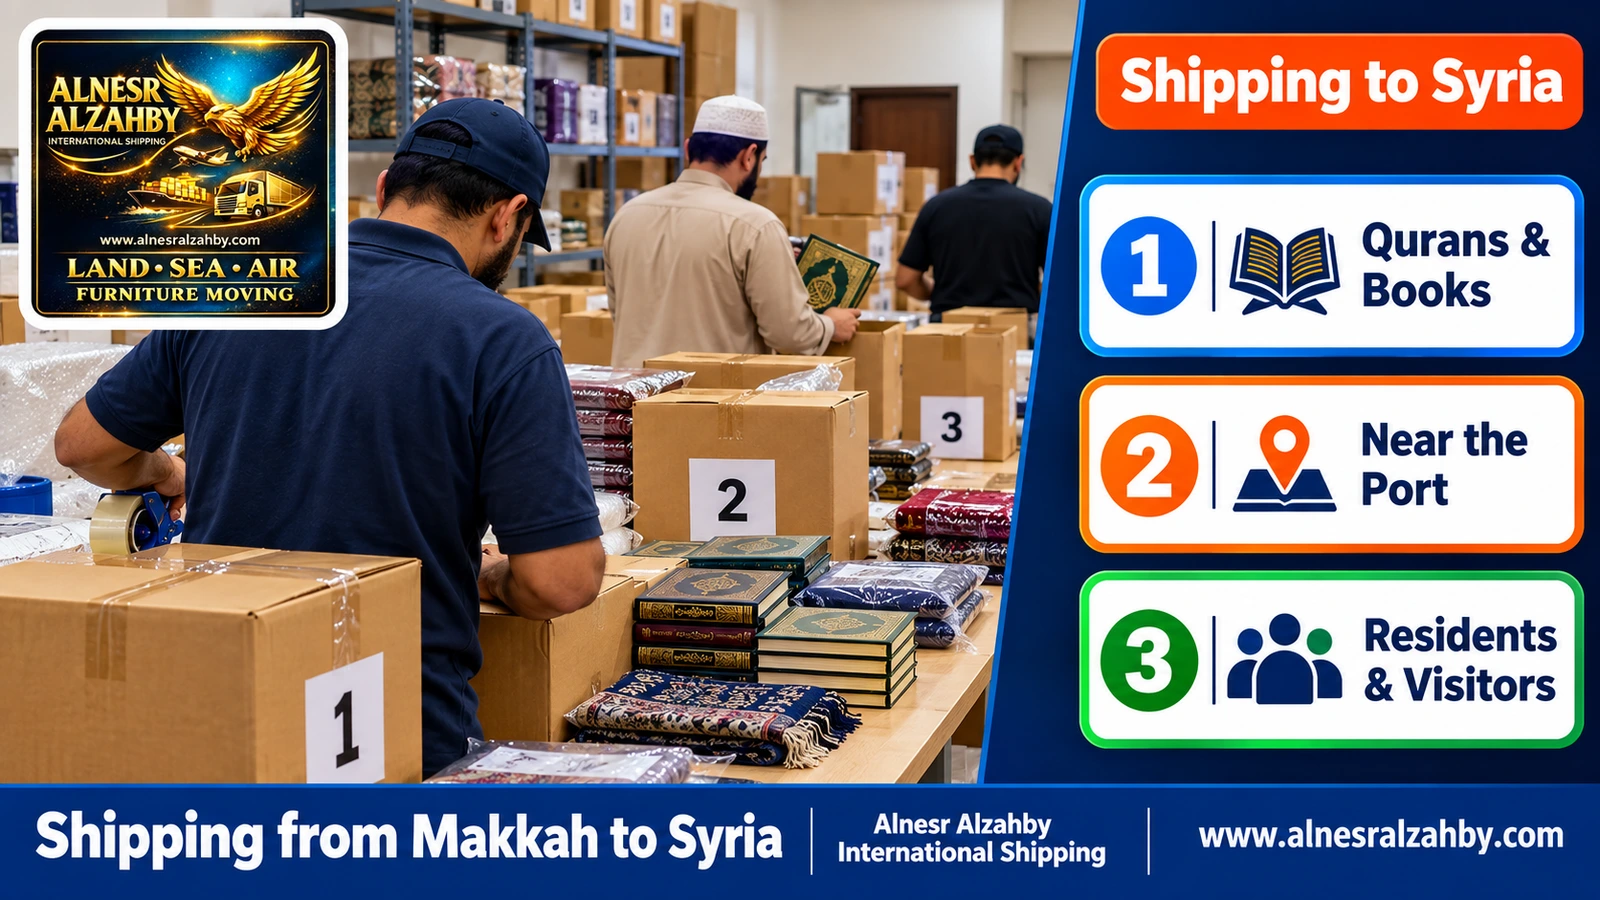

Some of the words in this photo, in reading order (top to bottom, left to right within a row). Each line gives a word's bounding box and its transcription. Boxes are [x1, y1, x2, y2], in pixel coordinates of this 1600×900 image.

[941, 412, 962, 442] 3
[718, 479, 747, 522] 2
[335, 691, 359, 768] 1
